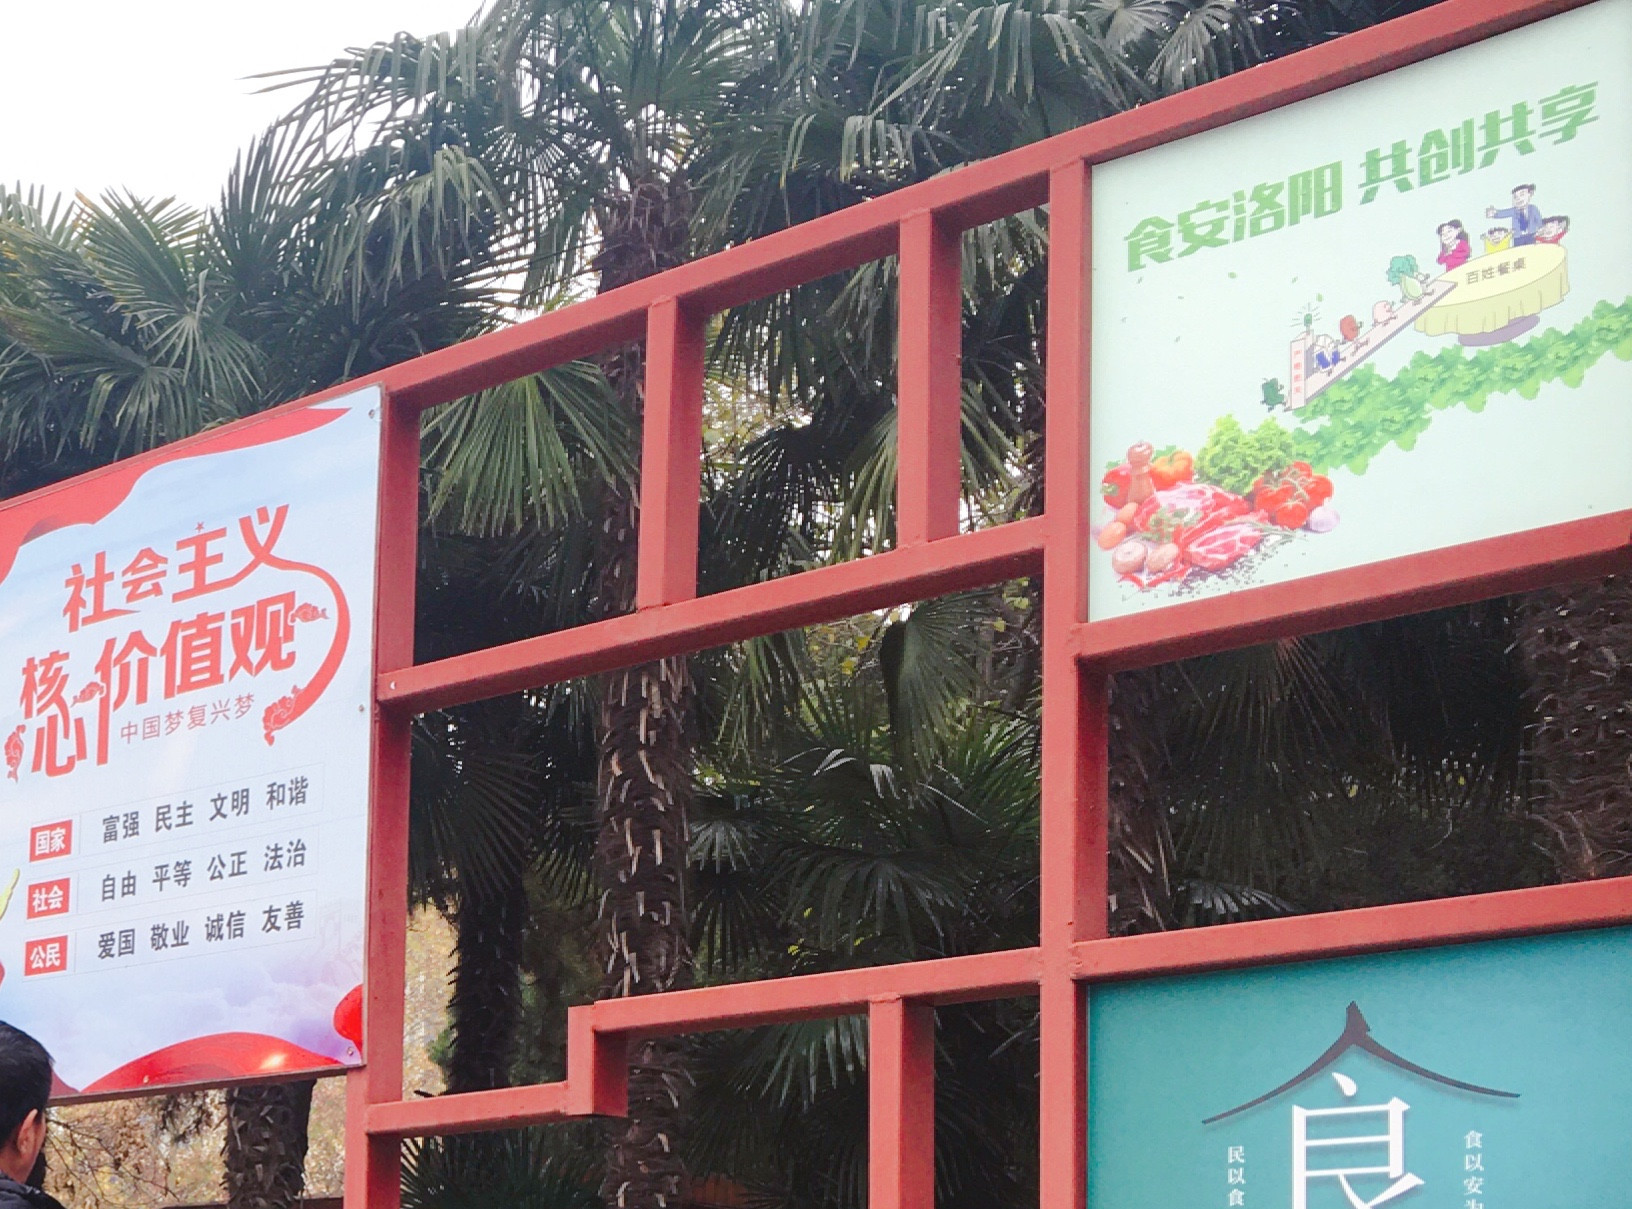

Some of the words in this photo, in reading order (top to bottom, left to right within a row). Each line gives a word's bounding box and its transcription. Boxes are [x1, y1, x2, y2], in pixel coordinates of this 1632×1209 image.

[1124, 161, 1343, 272] 食安洛阳
[1357, 81, 1599, 205] 共创共享
[1465, 257, 1527, 284] 百姓餐桌
[62, 503, 291, 633] 社会主义
[13, 591, 297, 778] 核心价值观
[120, 693, 255, 744] 中国梦复兴梦
[35, 827, 66, 856] 国家
[103, 814, 140, 843] 富强
[155, 801, 194, 832] 民主
[209, 788, 250, 822] 文明
[266, 776, 309, 810] 和谐
[32, 885, 64, 913] 社会
[101, 870, 137, 902] 自由
[153, 860, 192, 892] 平等
[207, 851, 248, 882] 公正
[263, 838, 307, 872] 法治
[29, 943, 61, 970] 公民
[98, 928, 136, 960] 爱国
[150, 920, 189, 952] 敬业
[205, 910, 246, 942] 诚信
[262, 900, 305, 933] 友善
